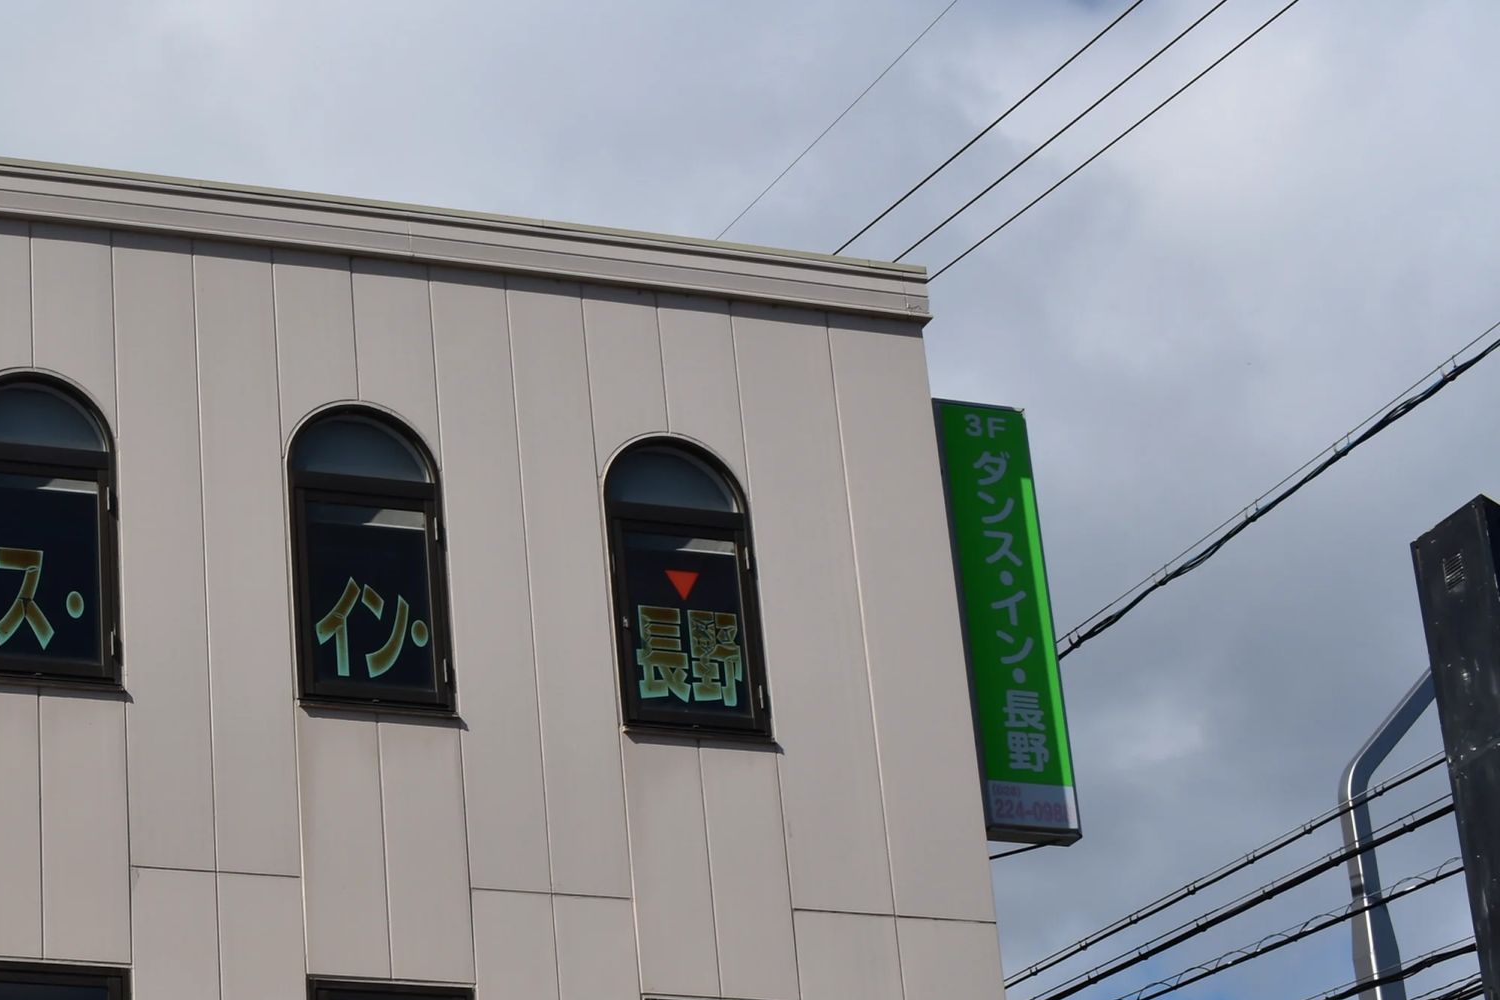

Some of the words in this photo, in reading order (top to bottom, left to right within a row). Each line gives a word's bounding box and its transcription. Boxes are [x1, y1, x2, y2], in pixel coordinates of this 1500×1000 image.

[964, 413, 1007, 438] 3F
[636, 604, 743, 707] 長野
[973, 451, 1050, 773] ダンス・イン・長野
